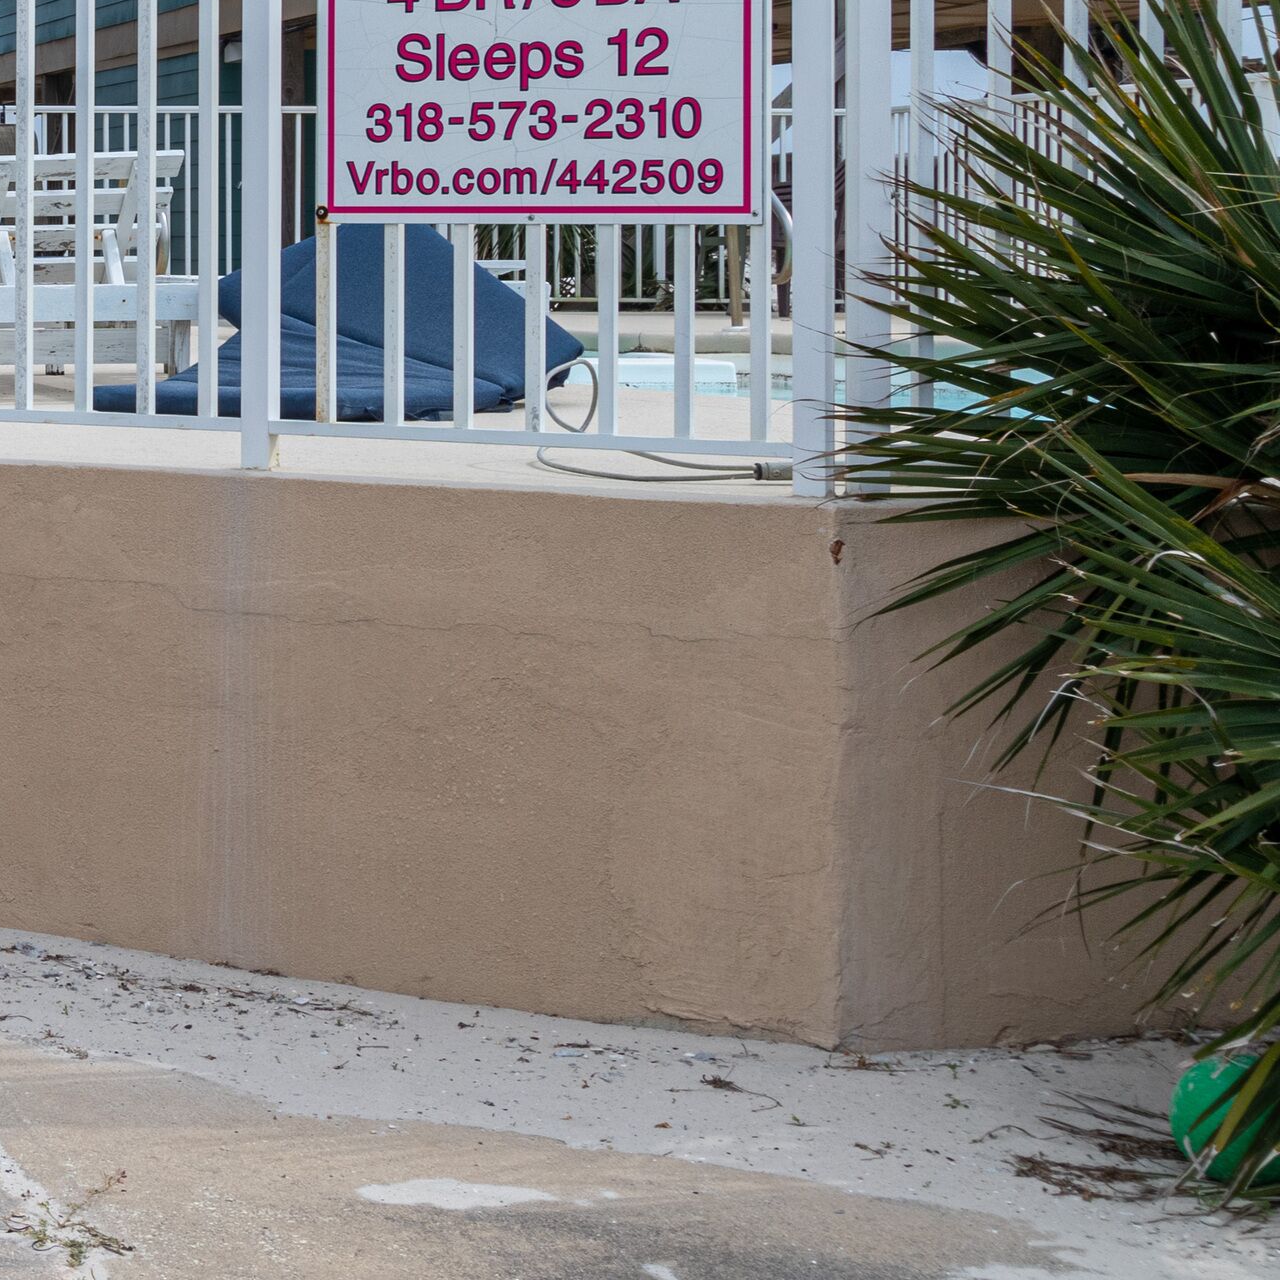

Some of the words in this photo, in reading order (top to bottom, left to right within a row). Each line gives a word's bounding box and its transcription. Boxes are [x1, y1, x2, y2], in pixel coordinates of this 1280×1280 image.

[395, 33, 584, 92] Sleeps
[607, 27, 669, 77] 12
[365, 96, 702, 143] 318-573-2310
[346, 158, 724, 196] Vrbo.com/442509
